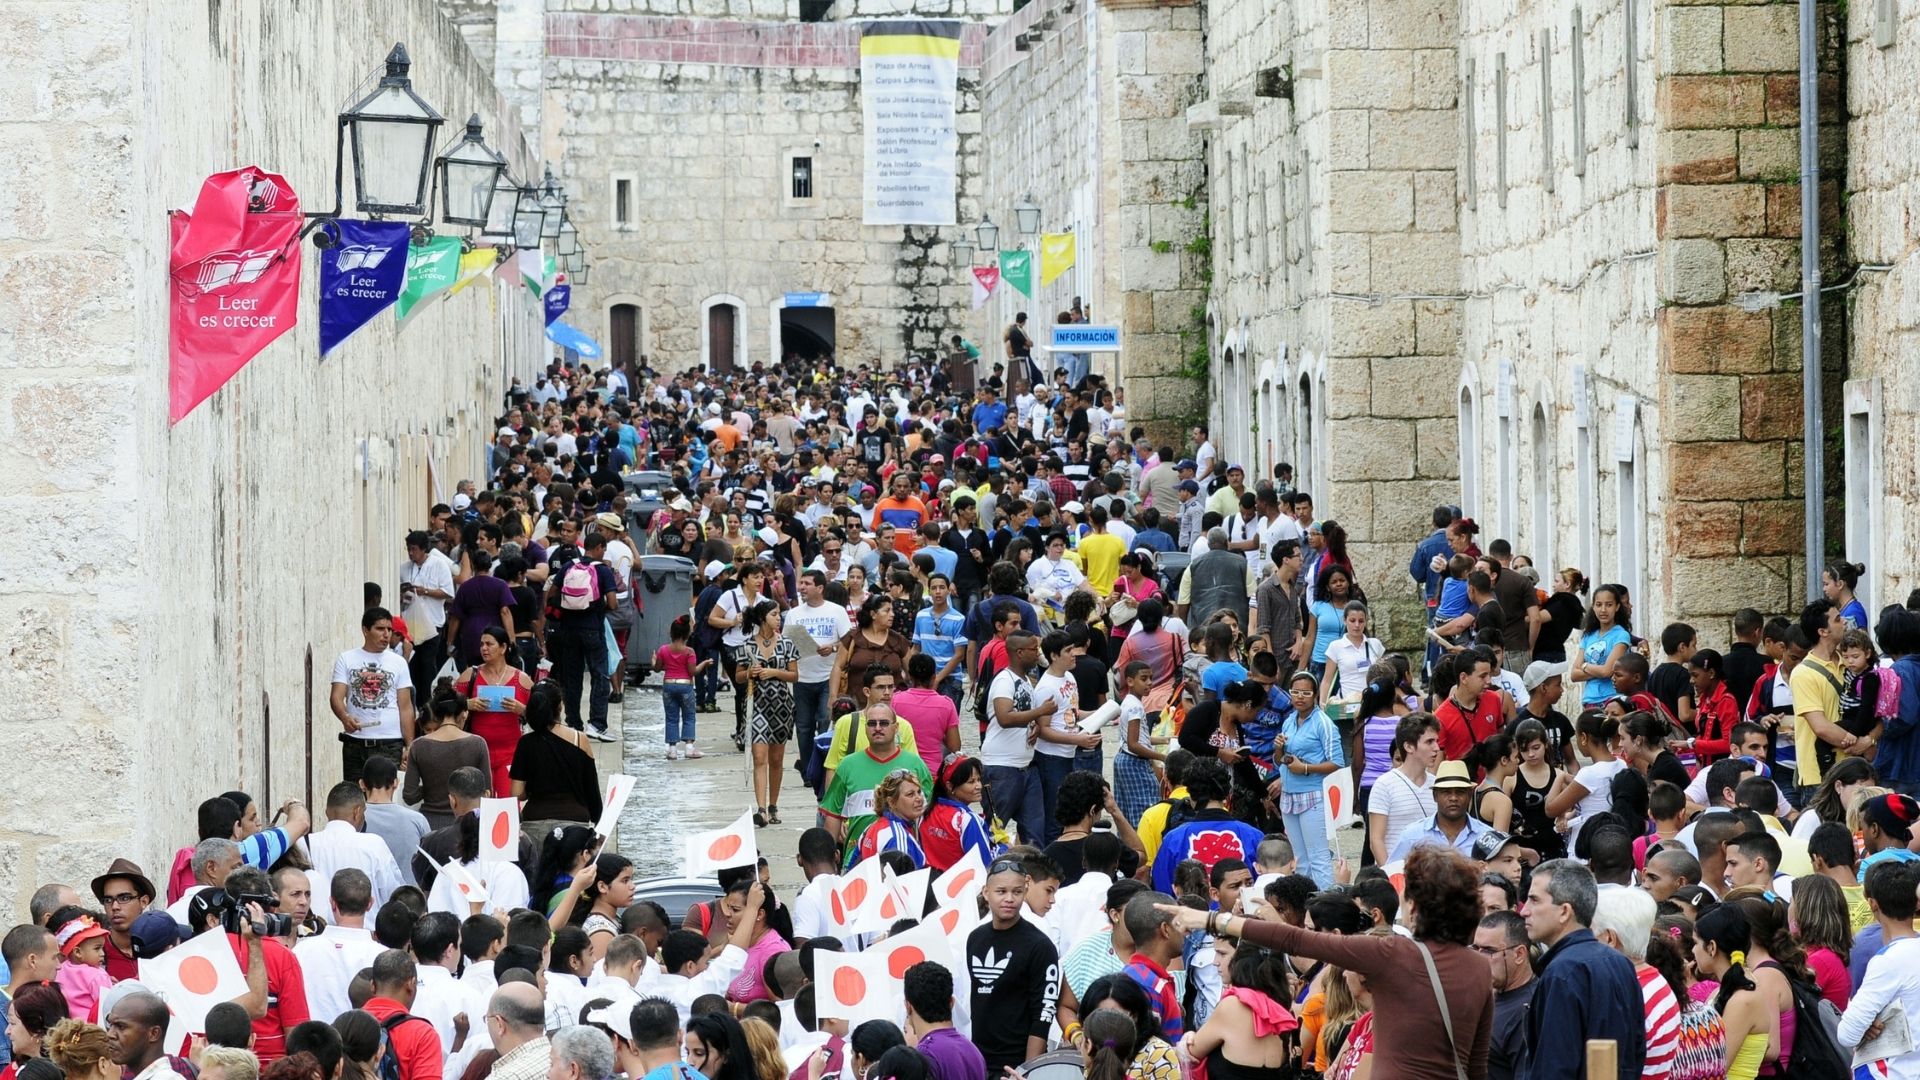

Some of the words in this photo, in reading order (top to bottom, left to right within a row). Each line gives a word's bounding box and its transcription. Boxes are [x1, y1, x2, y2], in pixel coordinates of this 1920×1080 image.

[908, 62, 931, 70] Armas
[875, 76, 901, 84] Carpas
[877, 126, 919, 134] Expositores
[899, 138, 937, 146] Profesional
[418, 266, 438, 275] Leer
[350, 274, 377, 287] Leer
[419, 272, 447, 282] crecer
[336, 286, 349, 297] es
[351, 288, 388, 299] crecer
[218, 294, 259, 311] Leer
[199, 315, 218, 327] es
[223, 314, 277, 328] crecer
[1056, 330, 1115, 341] INFORMACIÓN
[795, 617, 835, 625] CONVERSE
[817, 624, 833, 637] STAR
